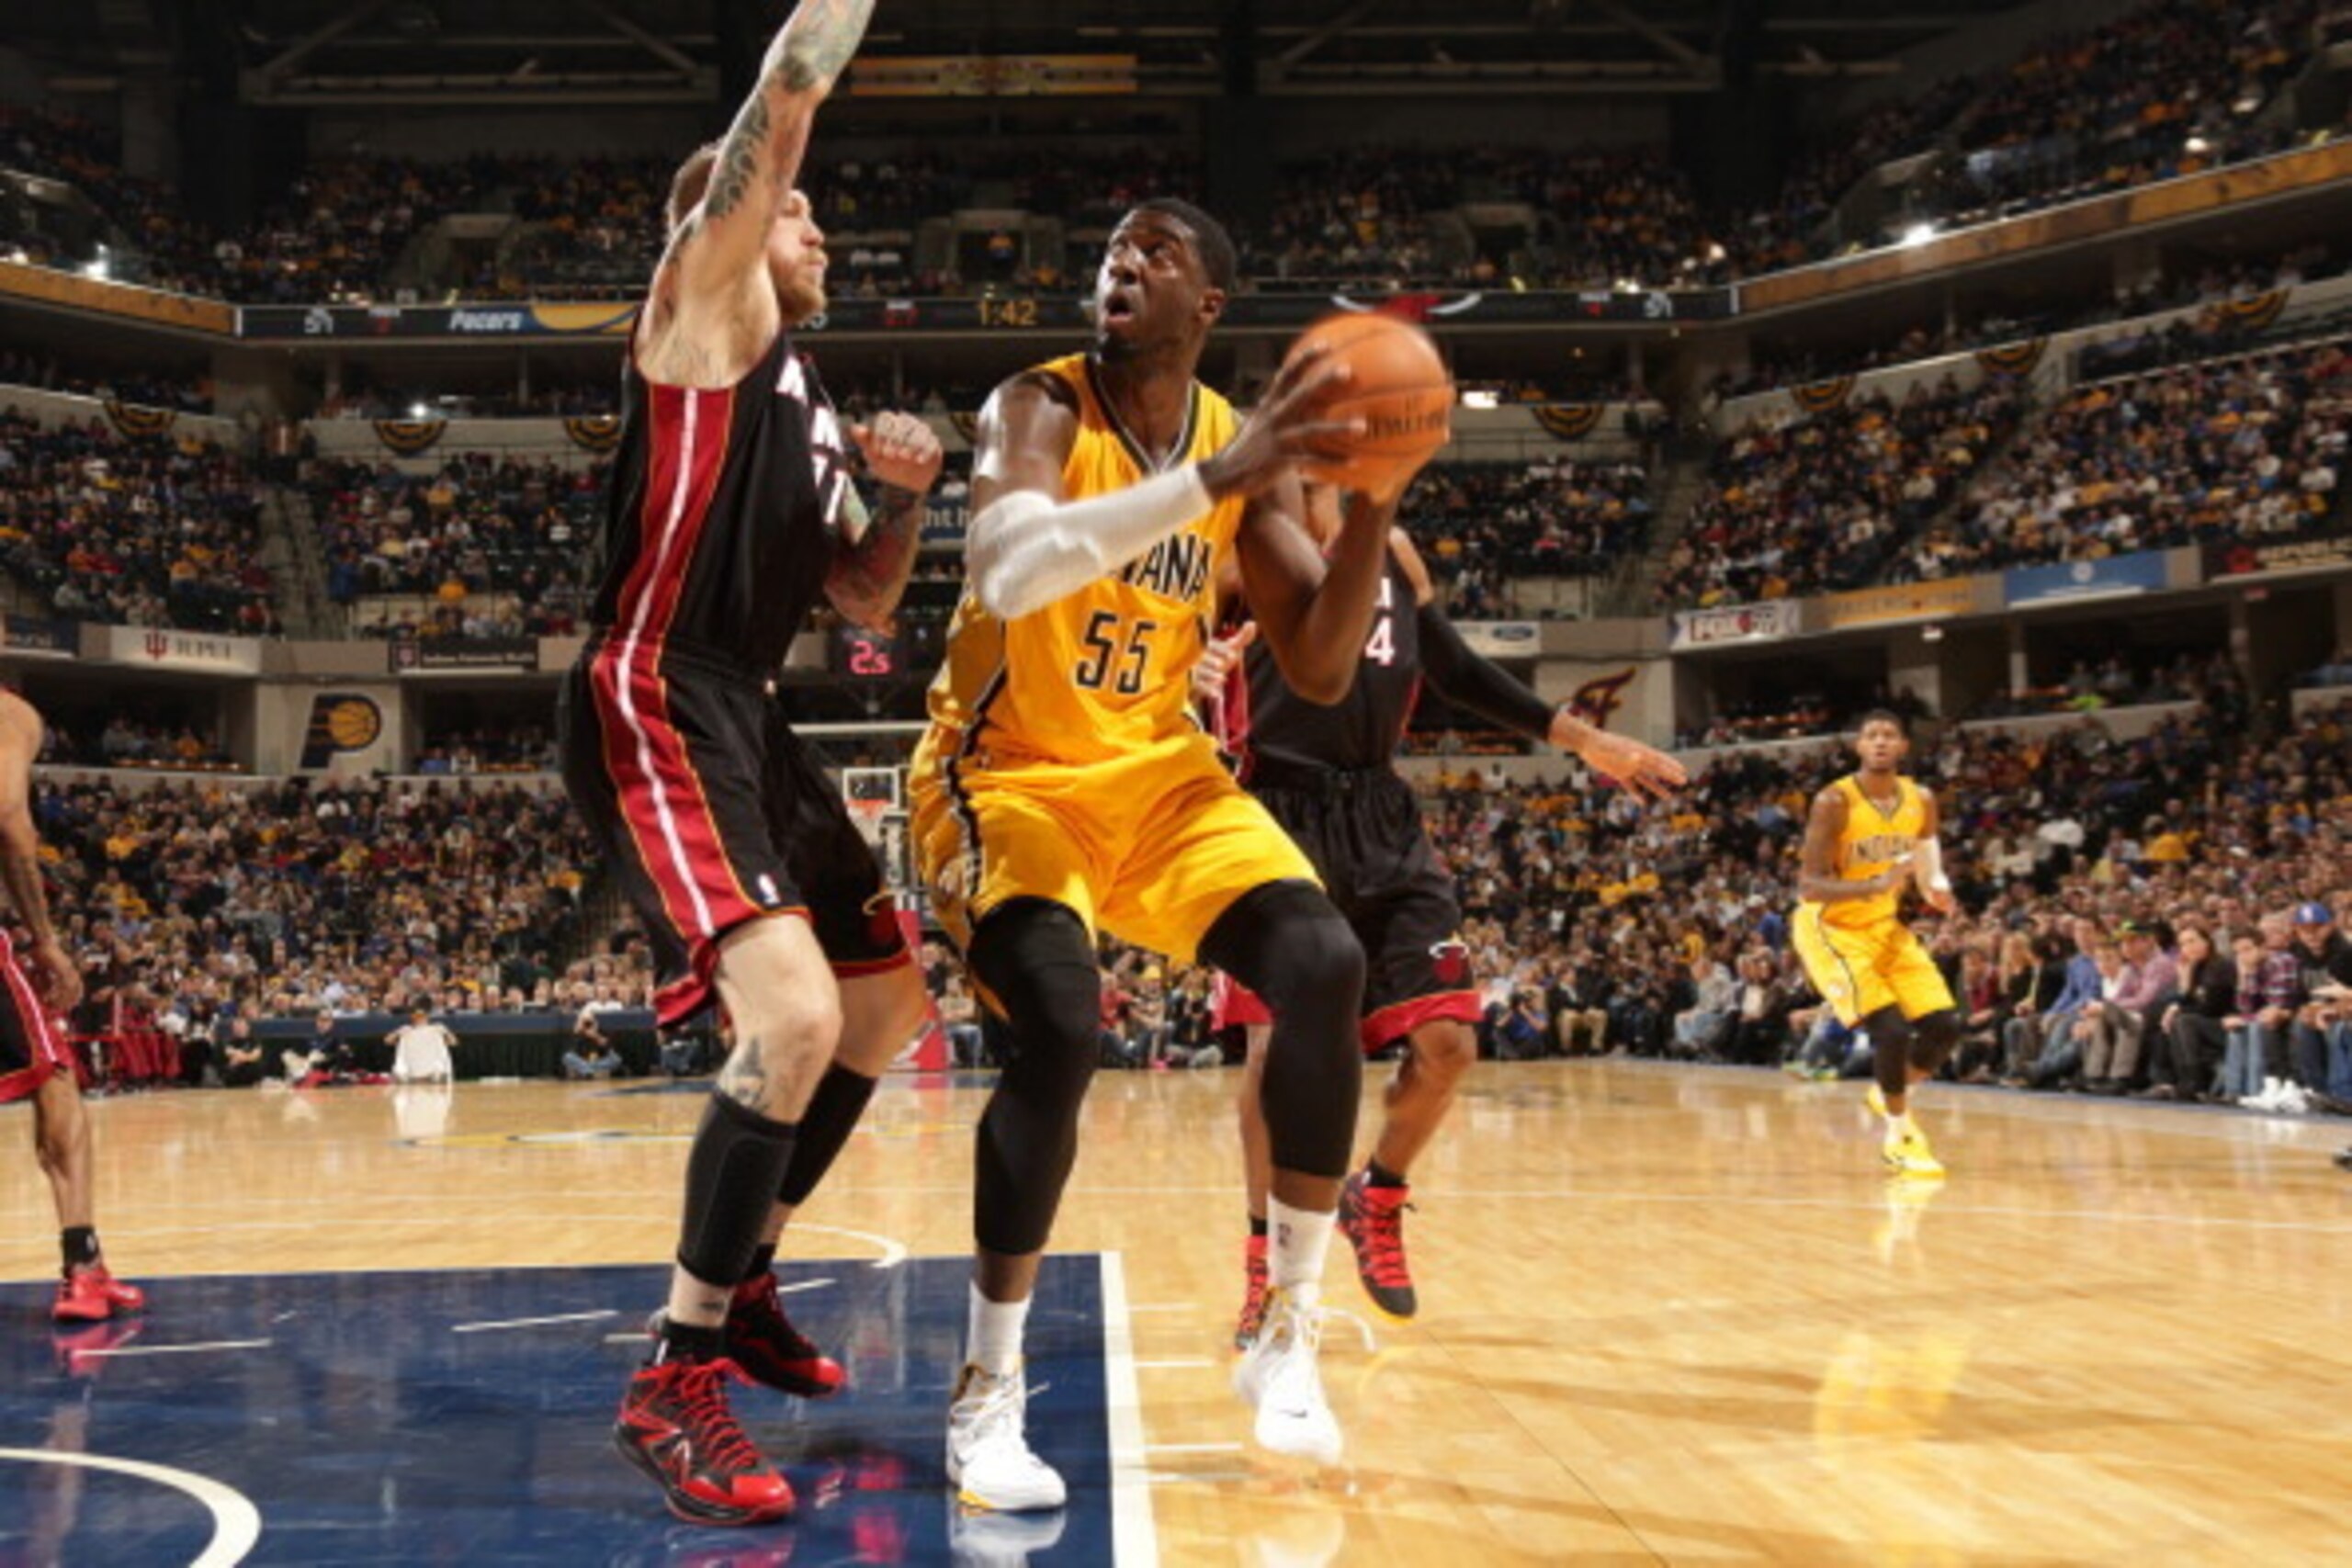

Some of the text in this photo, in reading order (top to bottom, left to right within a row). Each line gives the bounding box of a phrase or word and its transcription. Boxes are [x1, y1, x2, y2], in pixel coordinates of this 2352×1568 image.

[449, 310, 524, 332] Pacers
[979, 300, 1035, 325] 1:42
[1076, 612, 1156, 694] 55
